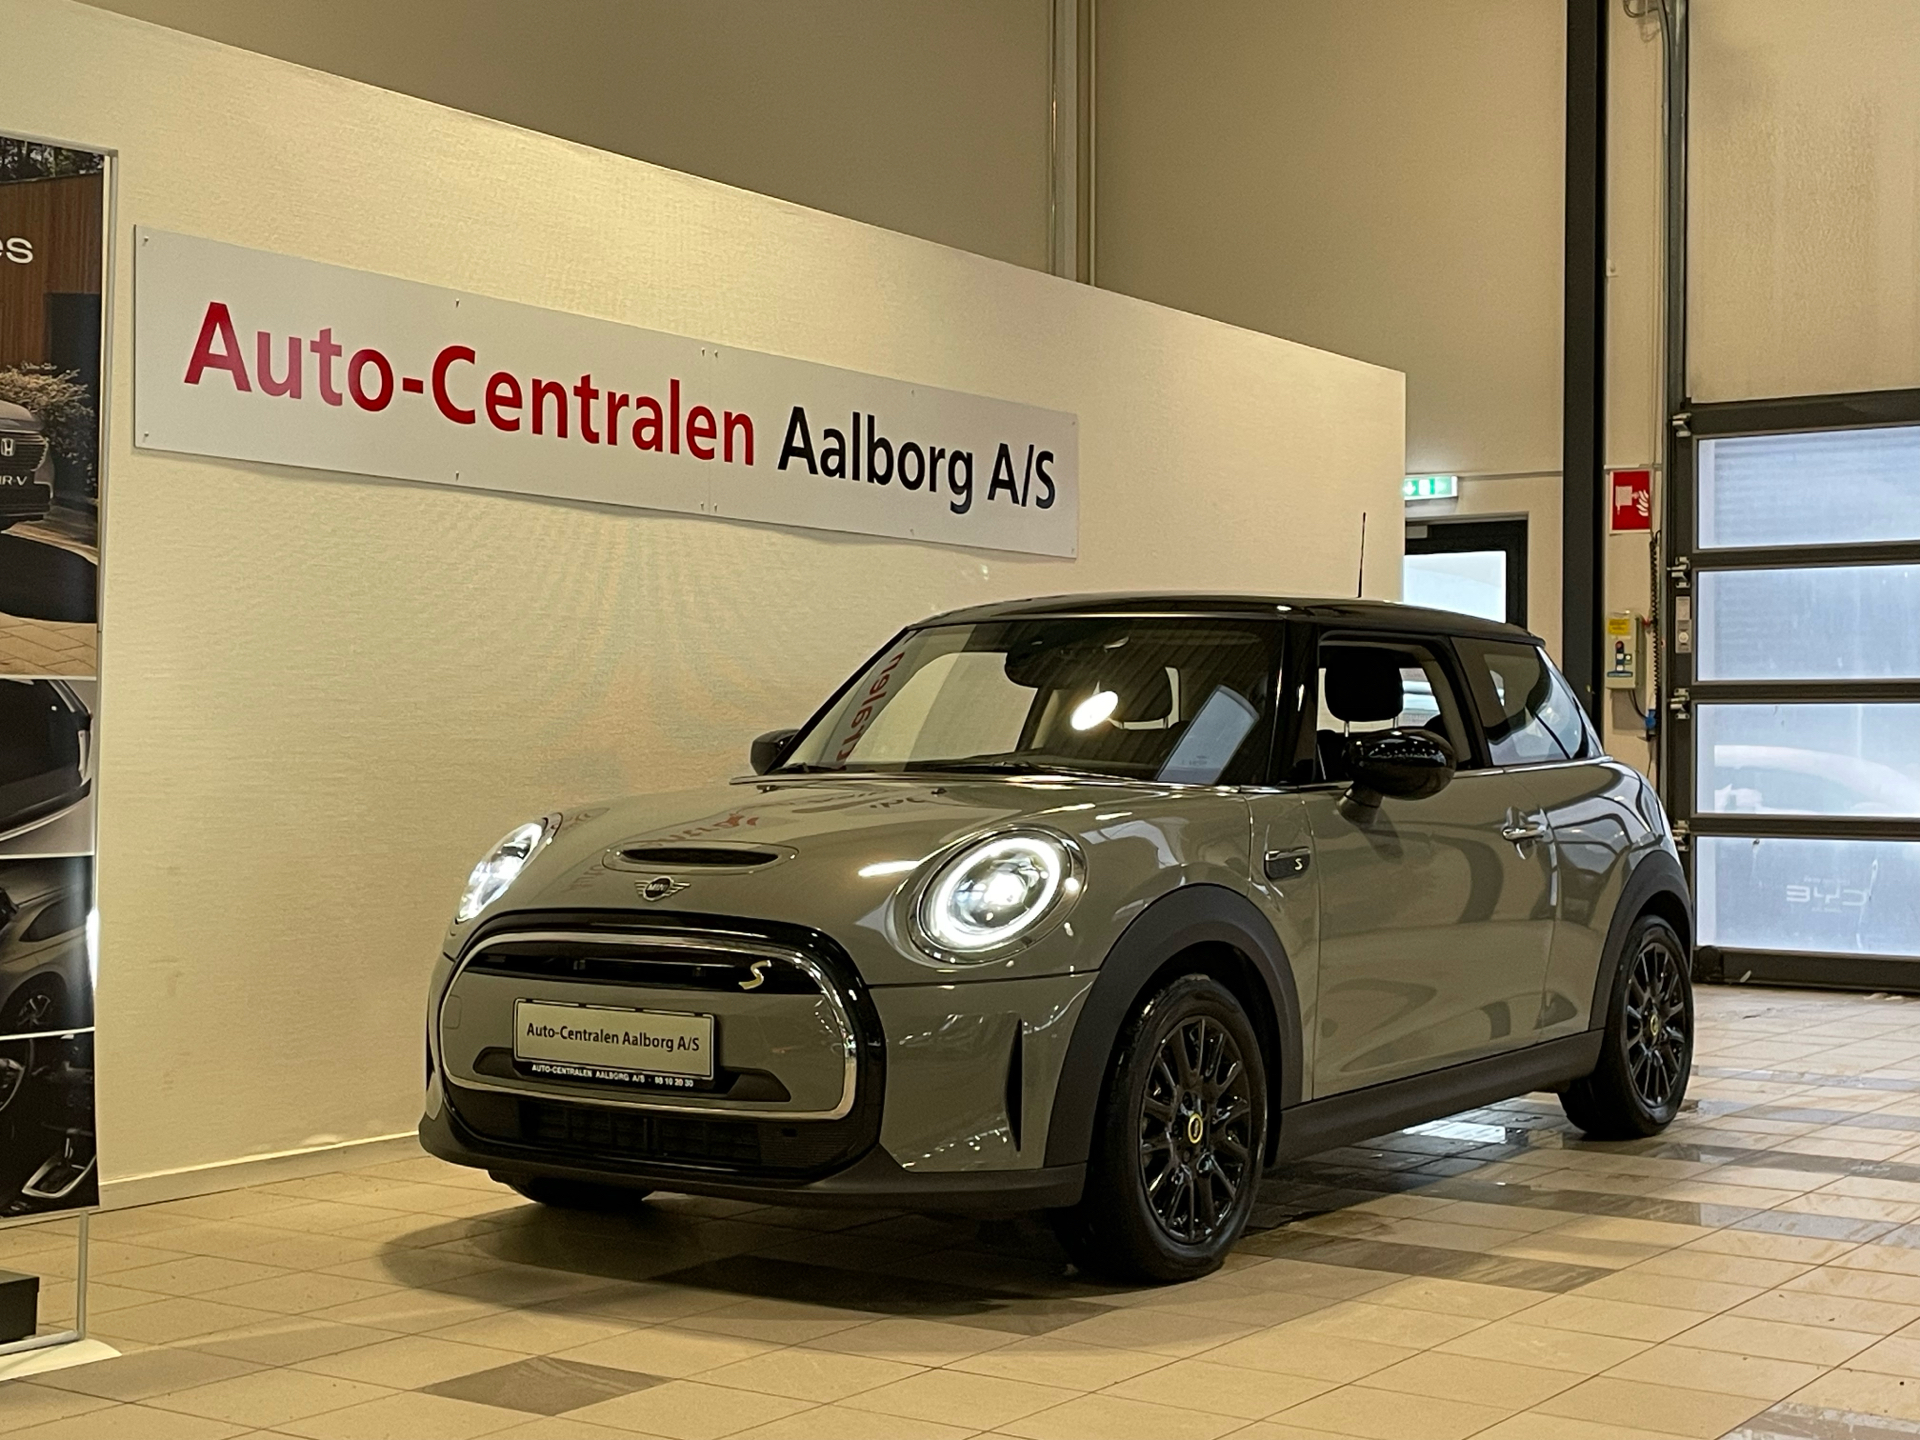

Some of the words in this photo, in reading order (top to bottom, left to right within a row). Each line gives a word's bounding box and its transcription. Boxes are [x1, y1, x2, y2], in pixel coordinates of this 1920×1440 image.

[0, 237, 34, 264] s
[184, 301, 755, 467] Auto-Centralen
[778, 407, 973, 515] Aalborg
[988, 442, 1056, 510] A/S
[0, 475, 28, 487] R-V
[738, 959, 772, 990] S
[526, 1022, 620, 1045] Auto-Centralen
[622, 1031, 674, 1053] Aalborg
[677, 1035, 700, 1052] A/S
[531, 1063, 593, 1078] AUTO-CENTRALEN
[595, 1070, 630, 1082] AALBORG
